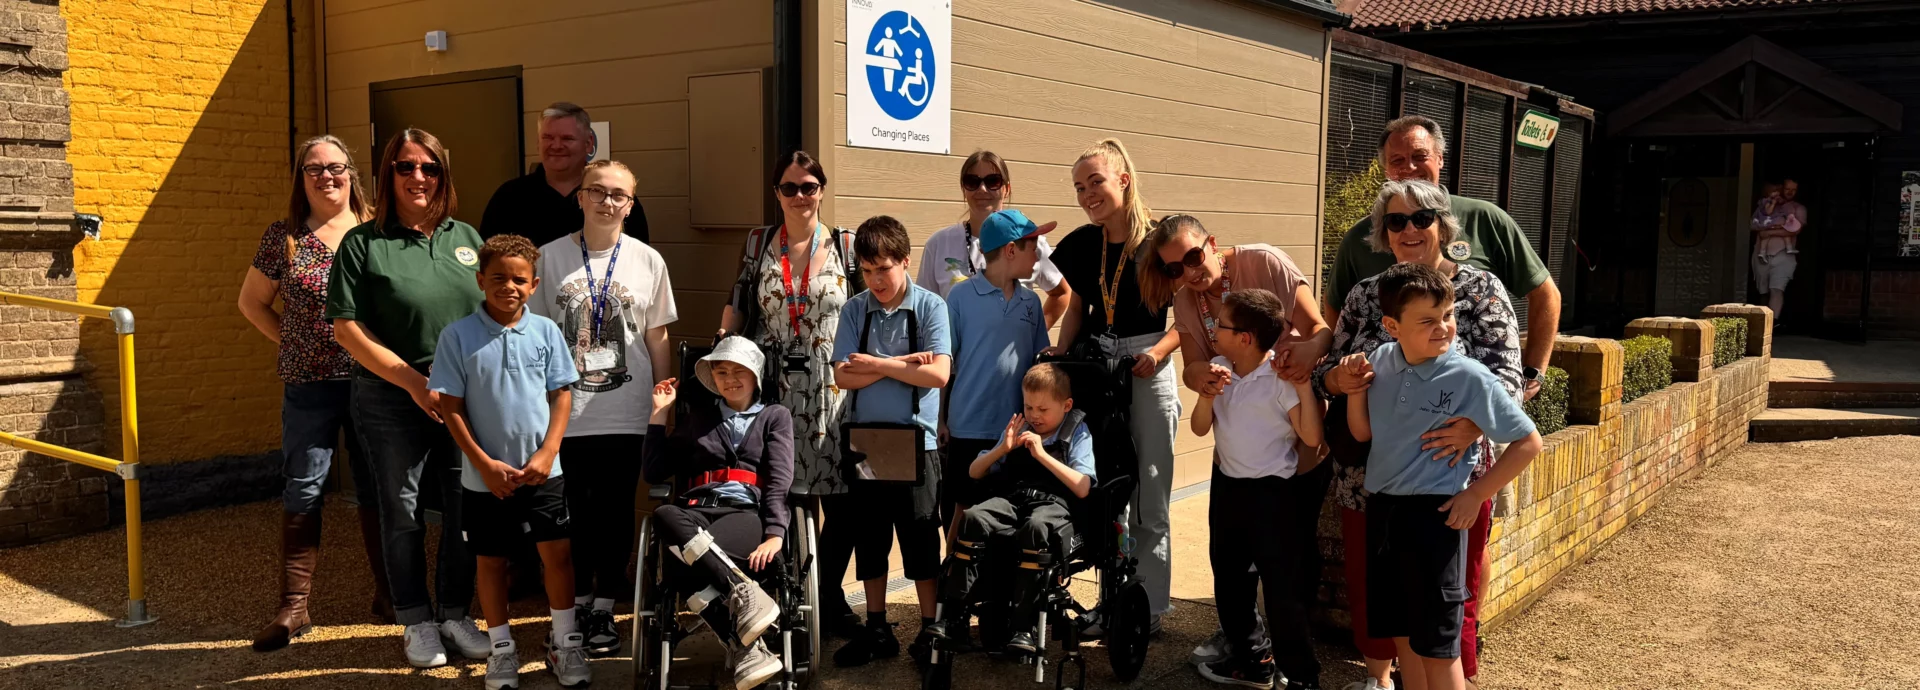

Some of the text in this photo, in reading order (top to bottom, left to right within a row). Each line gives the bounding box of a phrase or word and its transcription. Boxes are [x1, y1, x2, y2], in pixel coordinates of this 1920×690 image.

[872, 127, 930, 142] Changing Places
[1521, 119, 1541, 139] Toilets
